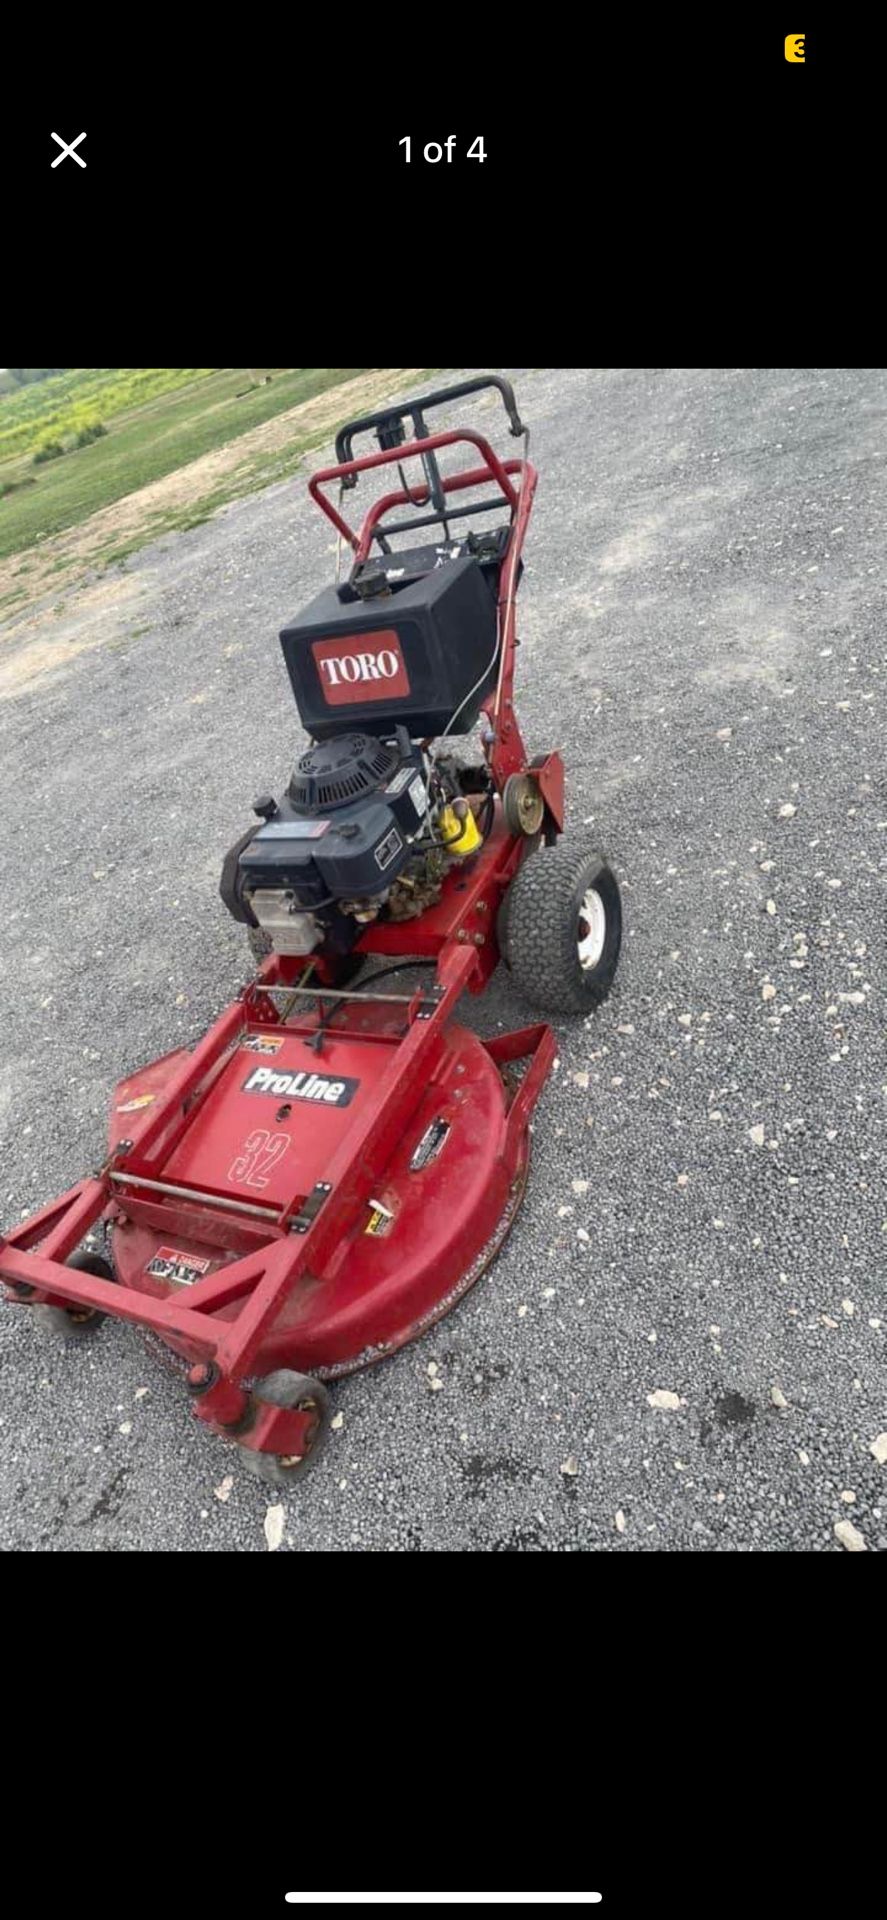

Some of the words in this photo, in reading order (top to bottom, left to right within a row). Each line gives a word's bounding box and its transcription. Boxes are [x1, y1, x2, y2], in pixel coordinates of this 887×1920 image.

[320, 650, 399, 685] TORO
[244, 1067, 346, 1102] ProLine
[227, 1129, 291, 1188] 32
